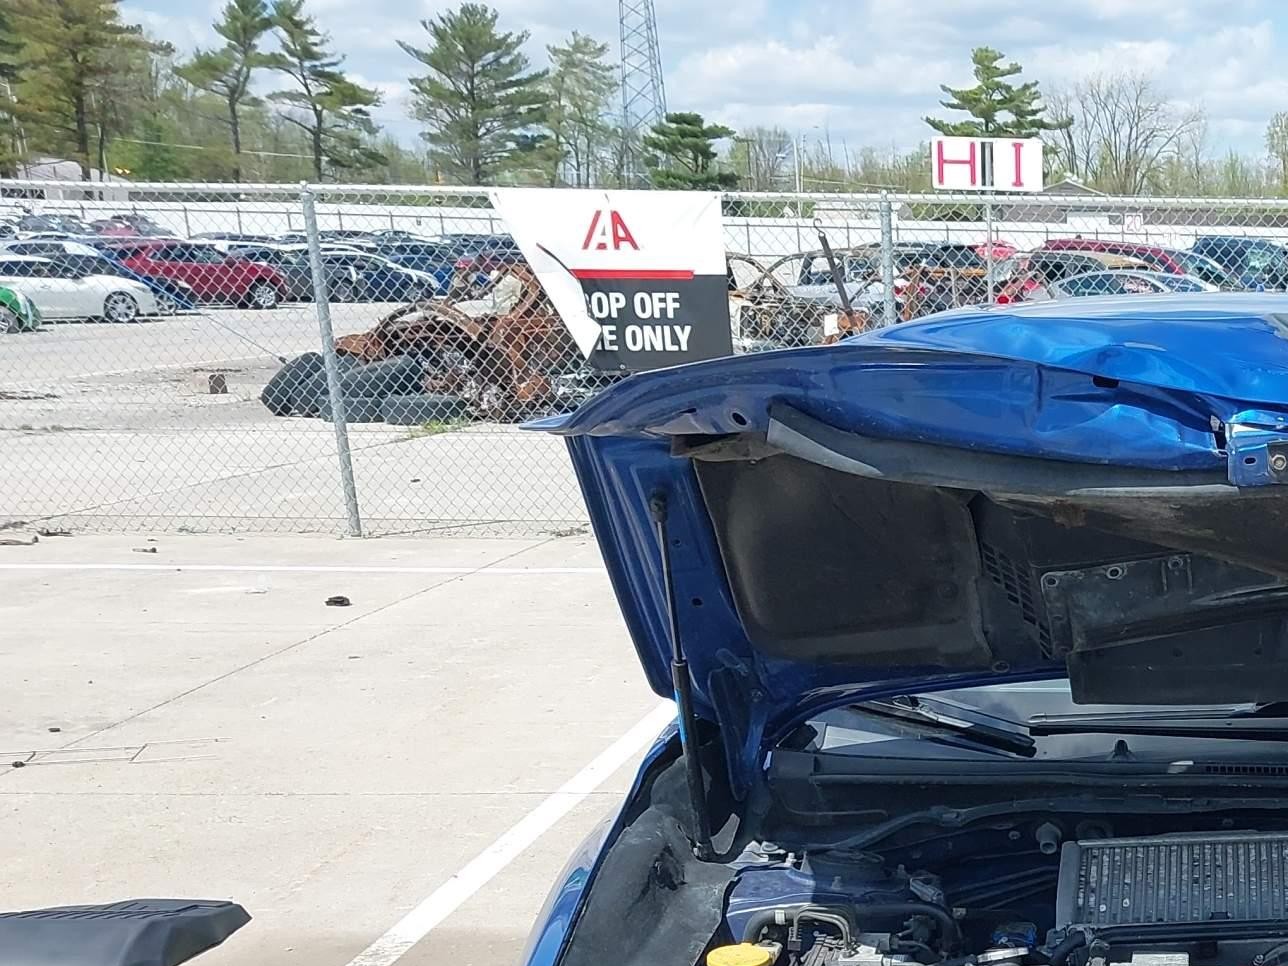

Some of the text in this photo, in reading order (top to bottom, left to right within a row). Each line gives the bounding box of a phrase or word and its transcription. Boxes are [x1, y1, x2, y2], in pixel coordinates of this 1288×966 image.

[585, 291, 681, 319] OP OFF
[624, 324, 692, 351] ONLY
